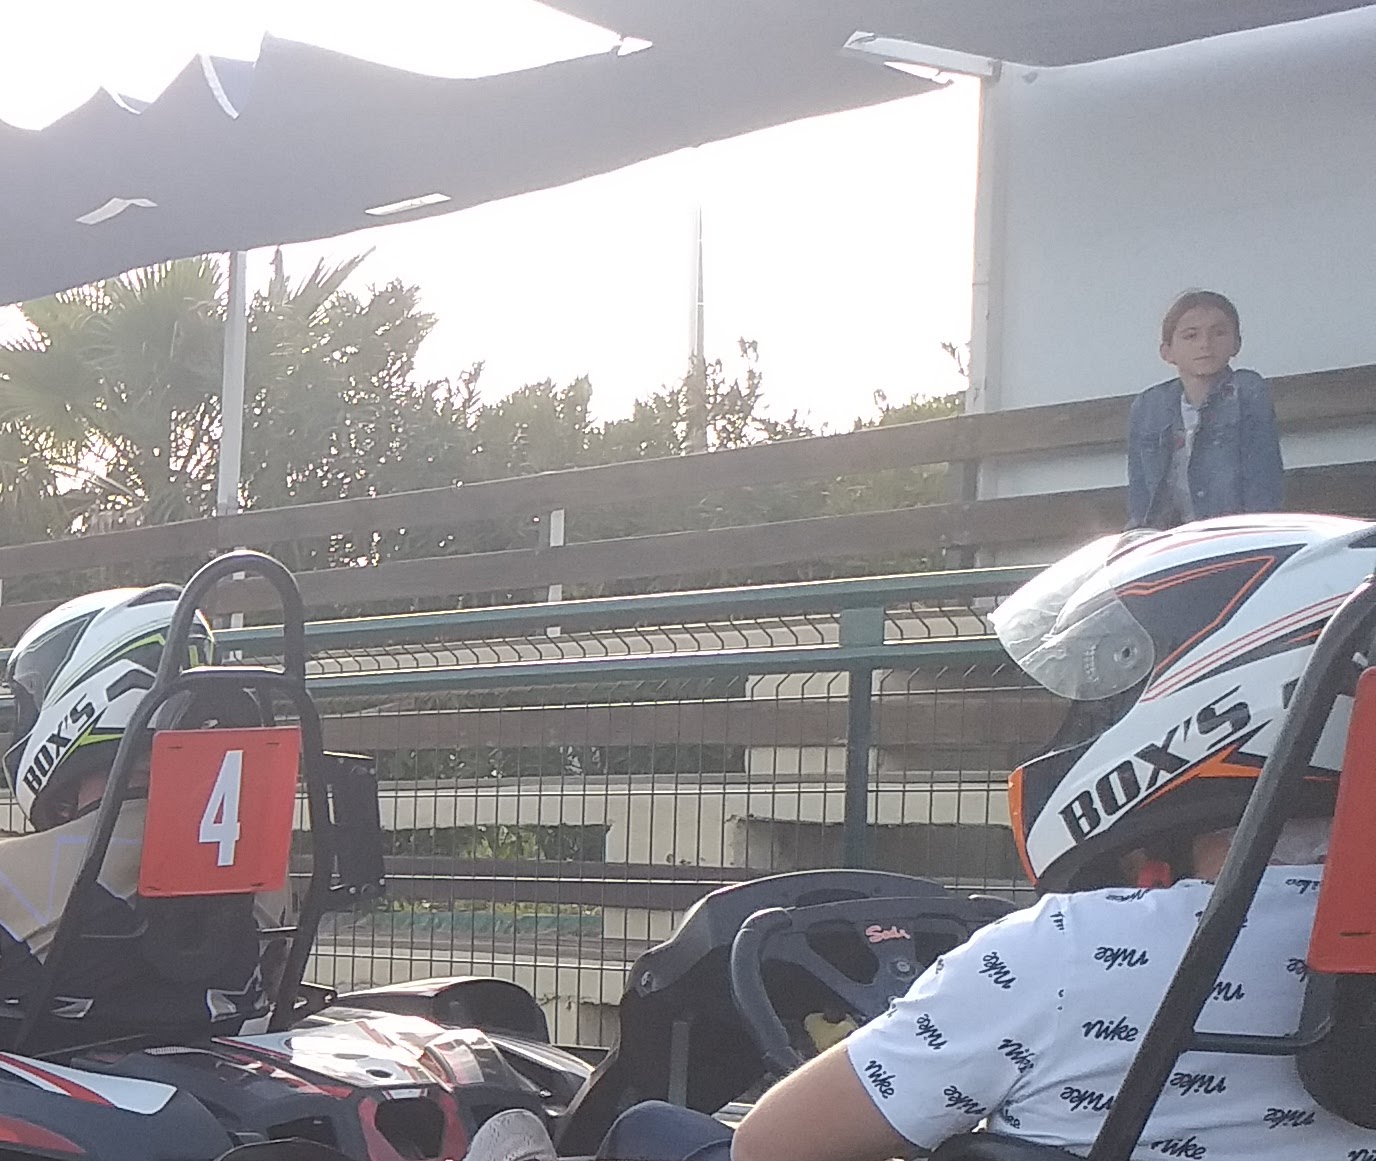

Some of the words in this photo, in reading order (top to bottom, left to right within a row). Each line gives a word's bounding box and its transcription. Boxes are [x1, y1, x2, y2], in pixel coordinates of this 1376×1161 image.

[23, 693, 95, 797] BOX'S
[1058, 684, 1251, 845] BOX'S
[198, 749, 243, 867] 4
